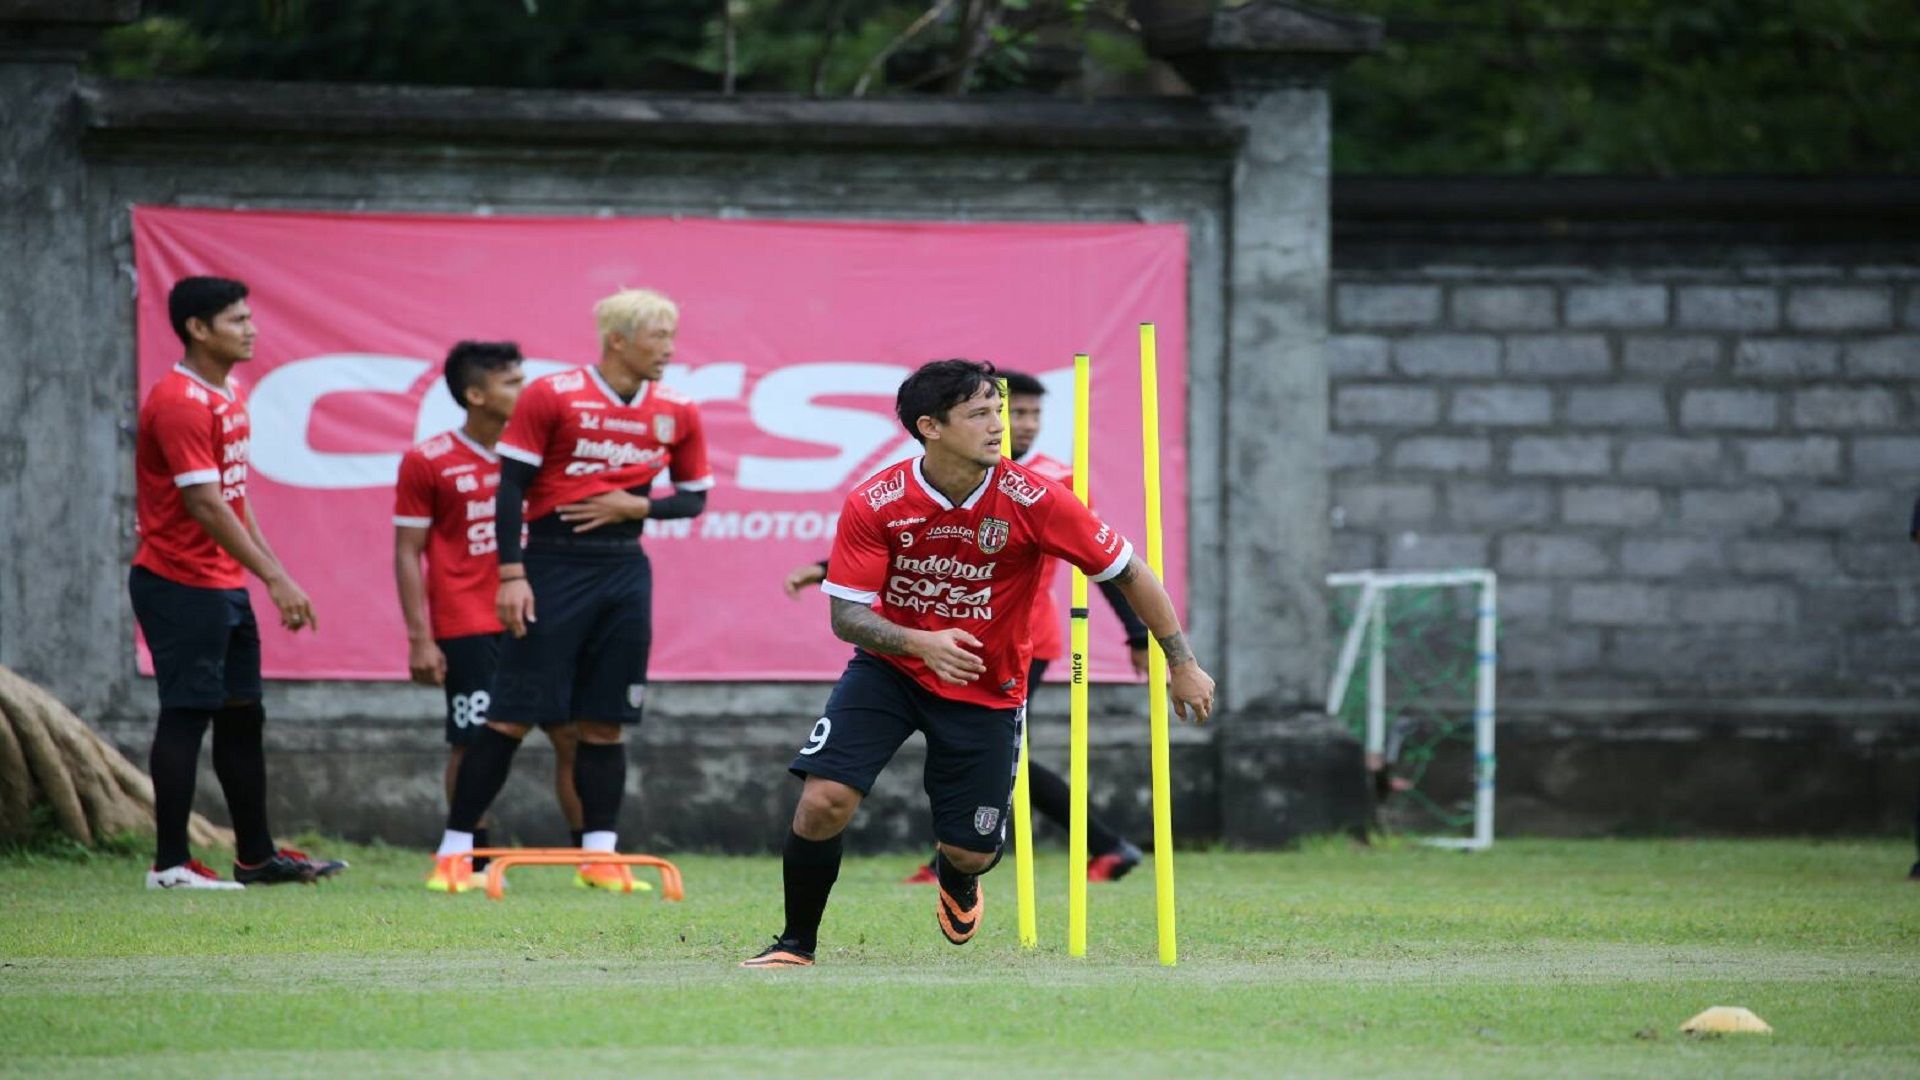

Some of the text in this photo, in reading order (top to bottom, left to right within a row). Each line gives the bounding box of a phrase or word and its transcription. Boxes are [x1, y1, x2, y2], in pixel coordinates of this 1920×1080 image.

[900, 531, 914, 548] 9
[885, 591, 992, 620] DATSUN
[1072, 653, 1082, 684] mitre
[452, 690, 491, 728] 88
[800, 717, 831, 755] 9
